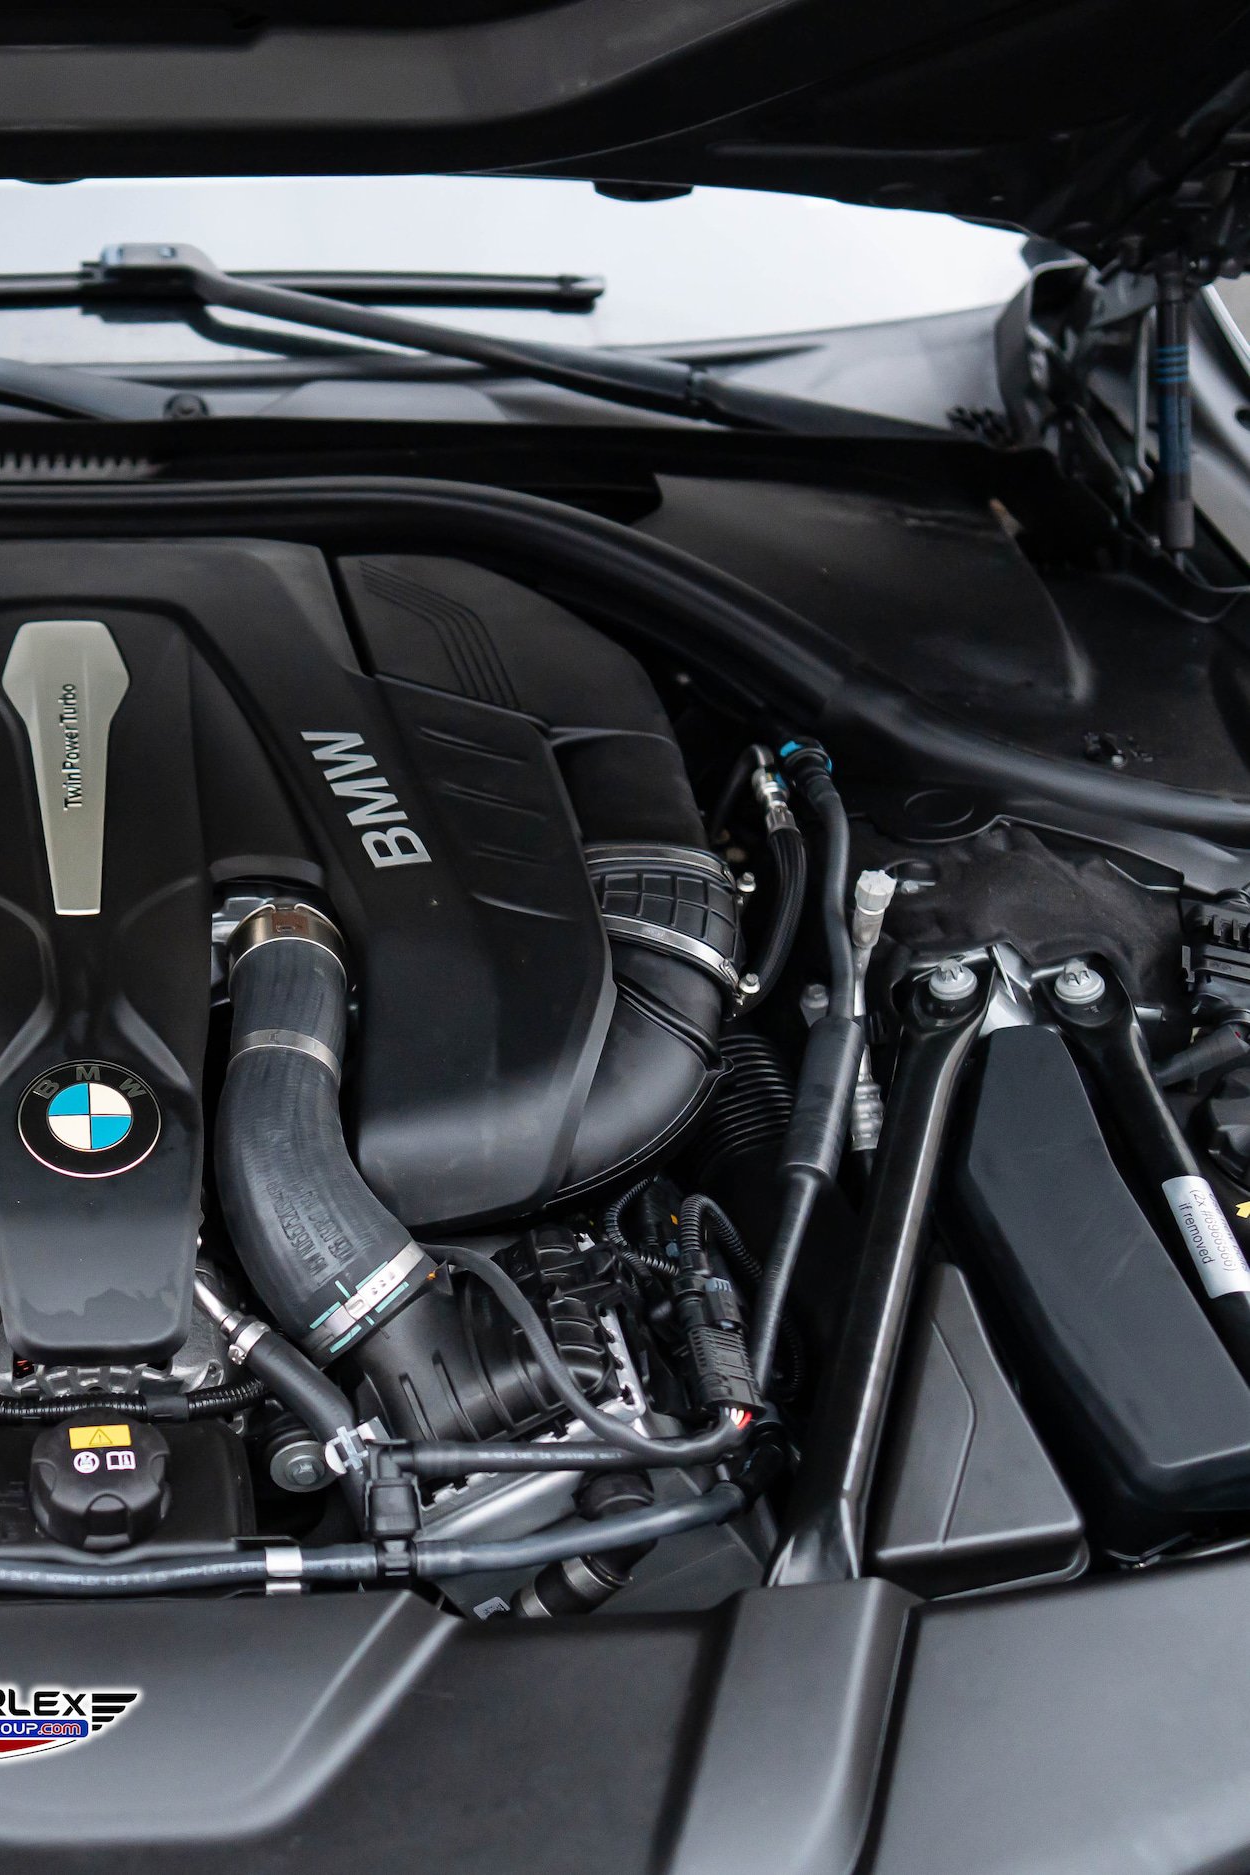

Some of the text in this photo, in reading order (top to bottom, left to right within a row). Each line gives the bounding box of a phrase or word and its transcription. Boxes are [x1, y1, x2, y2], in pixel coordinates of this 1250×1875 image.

[58, 683, 82, 811] TwinPower Turbo
[300, 731, 433, 869] BMW
[32, 1066, 147, 1100] BMW
[1178, 1202, 1215, 1264] if removed
